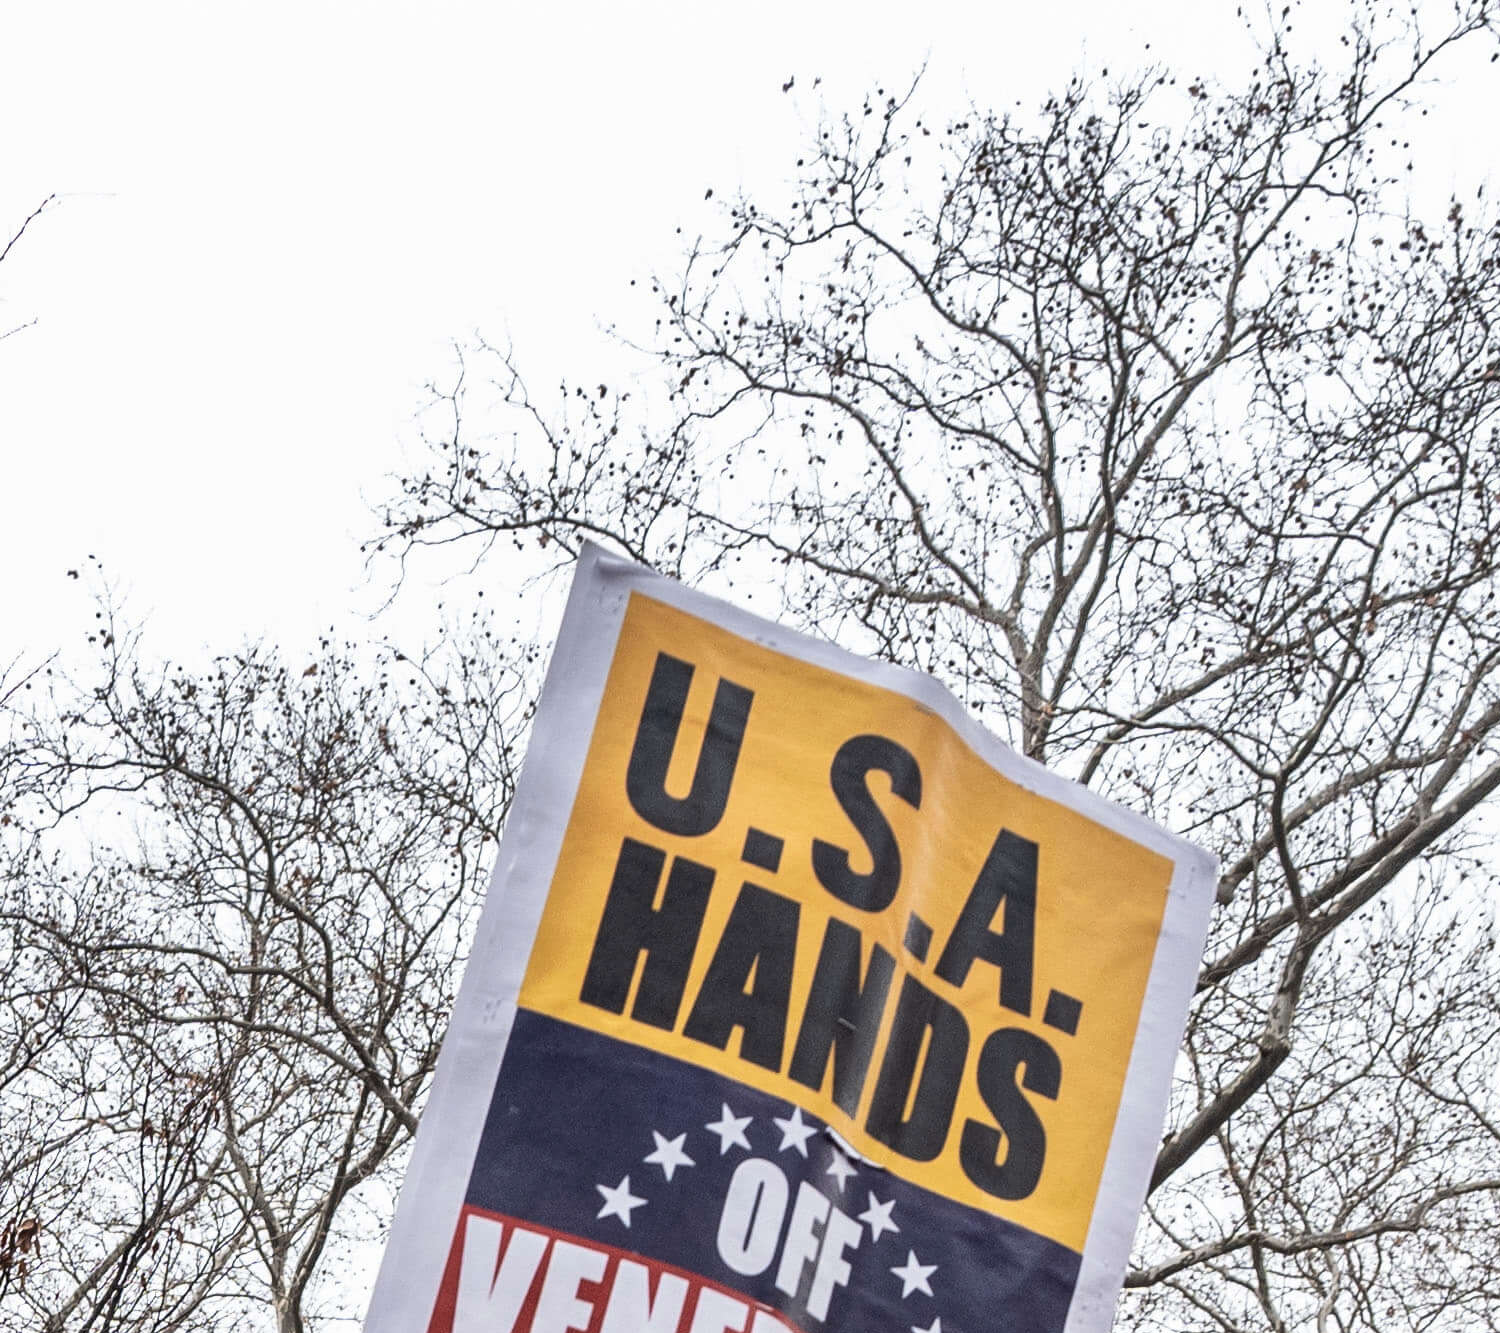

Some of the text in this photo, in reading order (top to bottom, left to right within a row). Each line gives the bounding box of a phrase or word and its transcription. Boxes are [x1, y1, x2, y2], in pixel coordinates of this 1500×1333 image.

[579, 836, 1062, 1201] HANDS
[625, 650, 1084, 1036] U.S.A.
[717, 1158, 862, 1323] OFF
